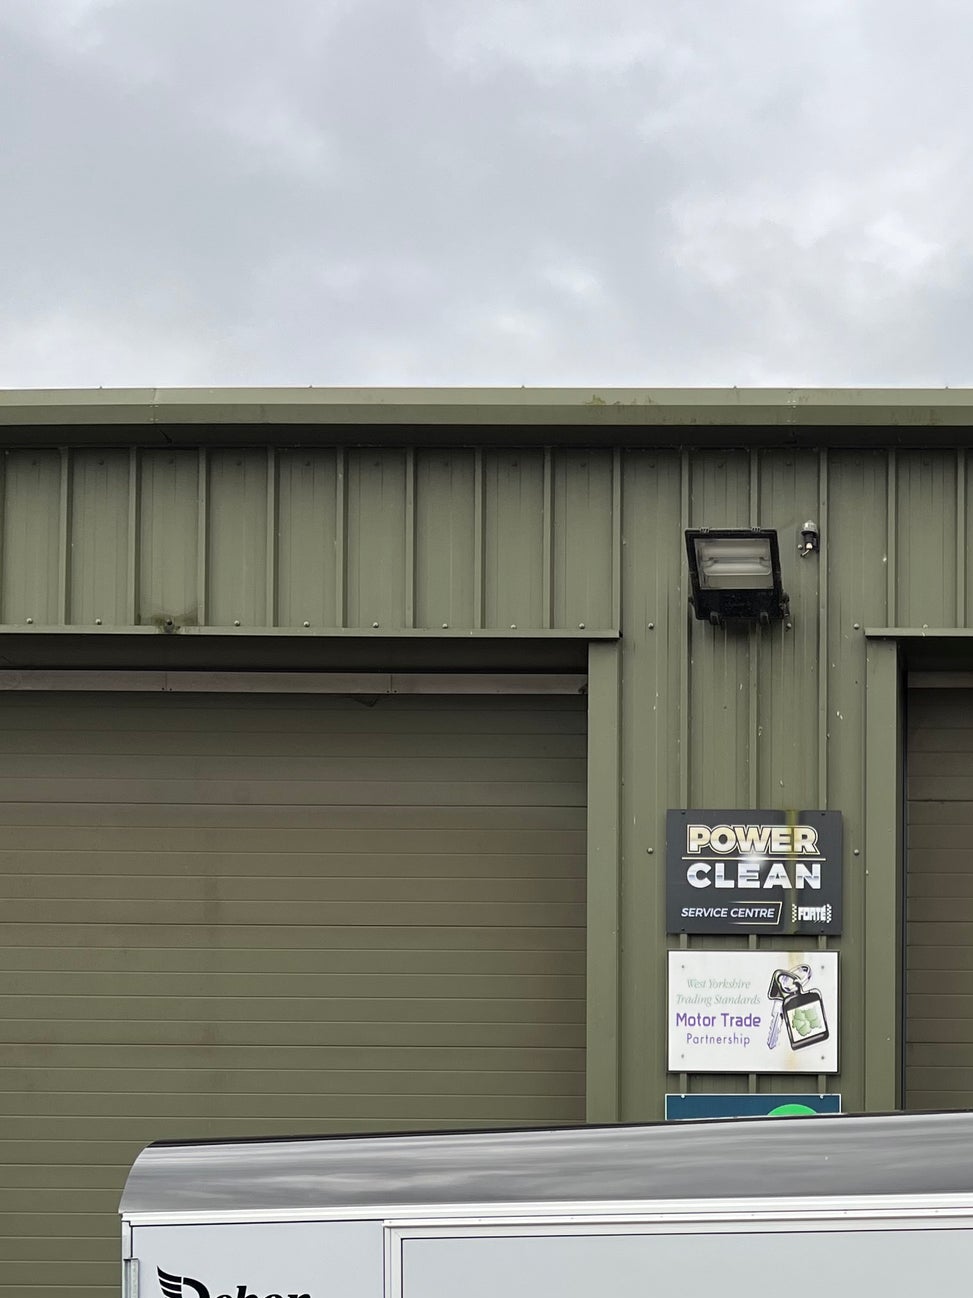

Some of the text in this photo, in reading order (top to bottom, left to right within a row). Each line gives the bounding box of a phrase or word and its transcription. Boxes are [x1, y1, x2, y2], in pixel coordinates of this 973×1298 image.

[686, 824, 820, 855] POWER
[686, 862, 821, 889] CLEAN
[681, 907, 775, 918] SERVICE CENTRE
[686, 978, 752, 989] West Yorkshire
[676, 994, 761, 1007] Trading Standards
[676, 1012, 762, 1027] Motor Trade
[686, 1032, 751, 1048] Partnership
